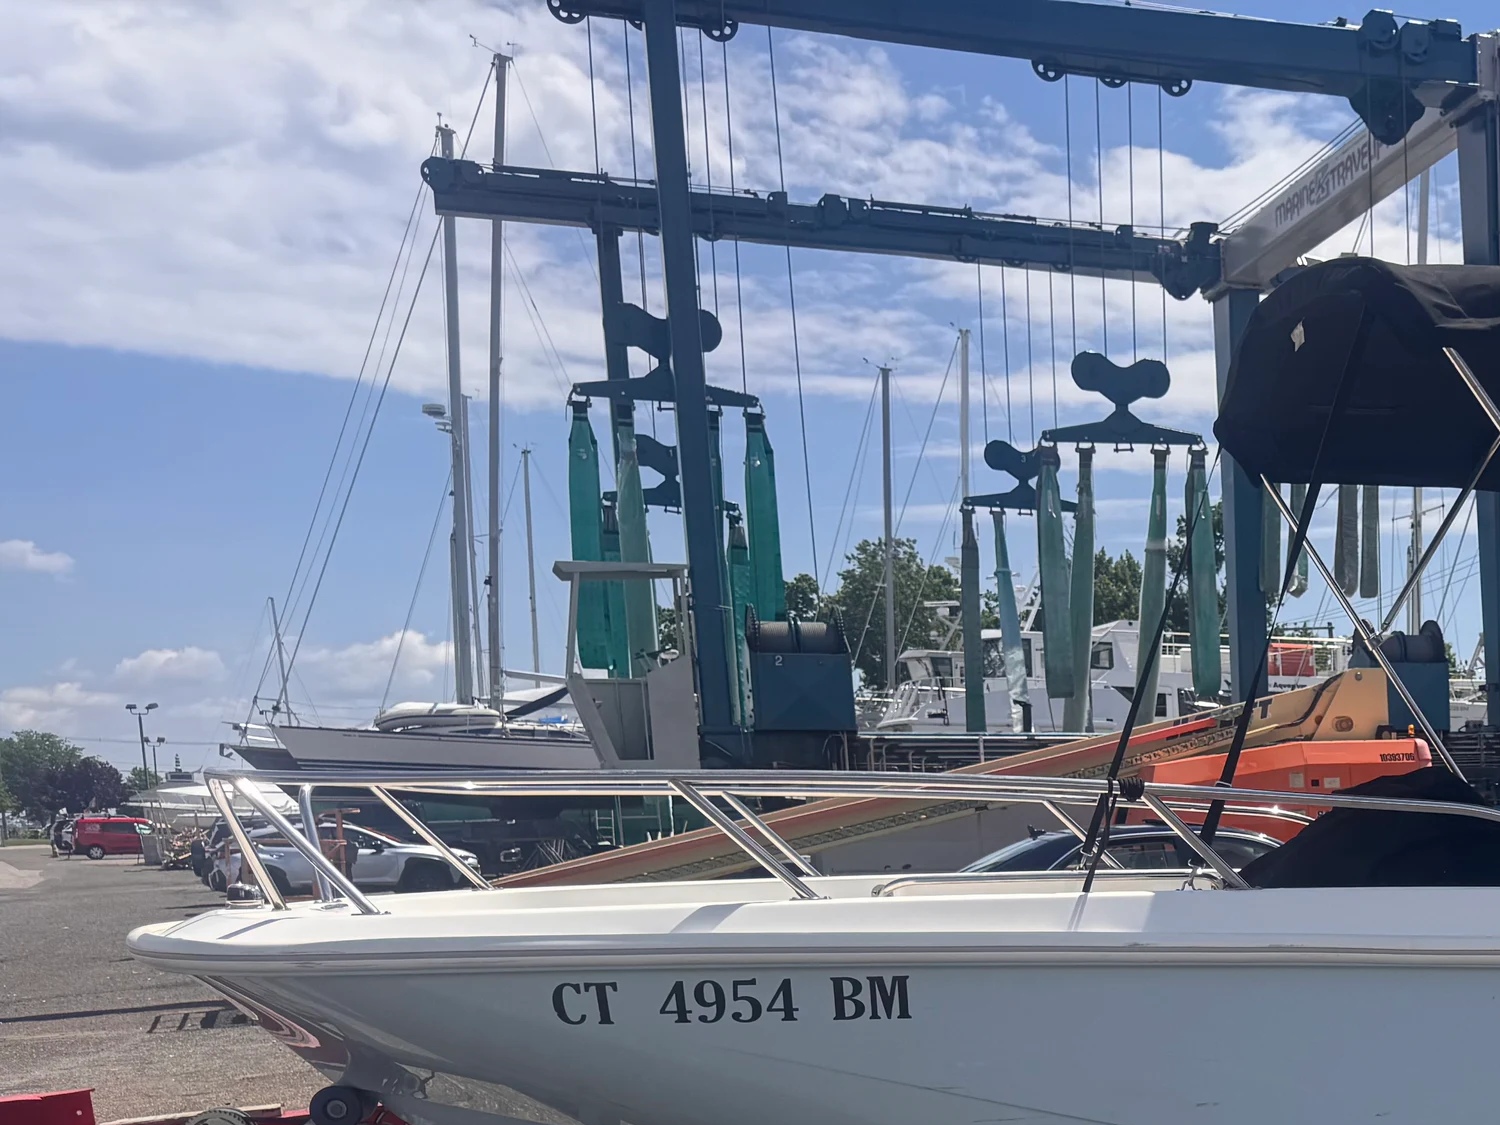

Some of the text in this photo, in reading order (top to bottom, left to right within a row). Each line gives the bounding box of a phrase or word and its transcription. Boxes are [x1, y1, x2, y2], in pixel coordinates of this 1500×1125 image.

[1275, 184, 1317, 228] MARINE
[1020, 454, 1027, 463] 3
[775, 655, 783, 666] 2
[552, 975, 912, 1025] CT 4954 BM
